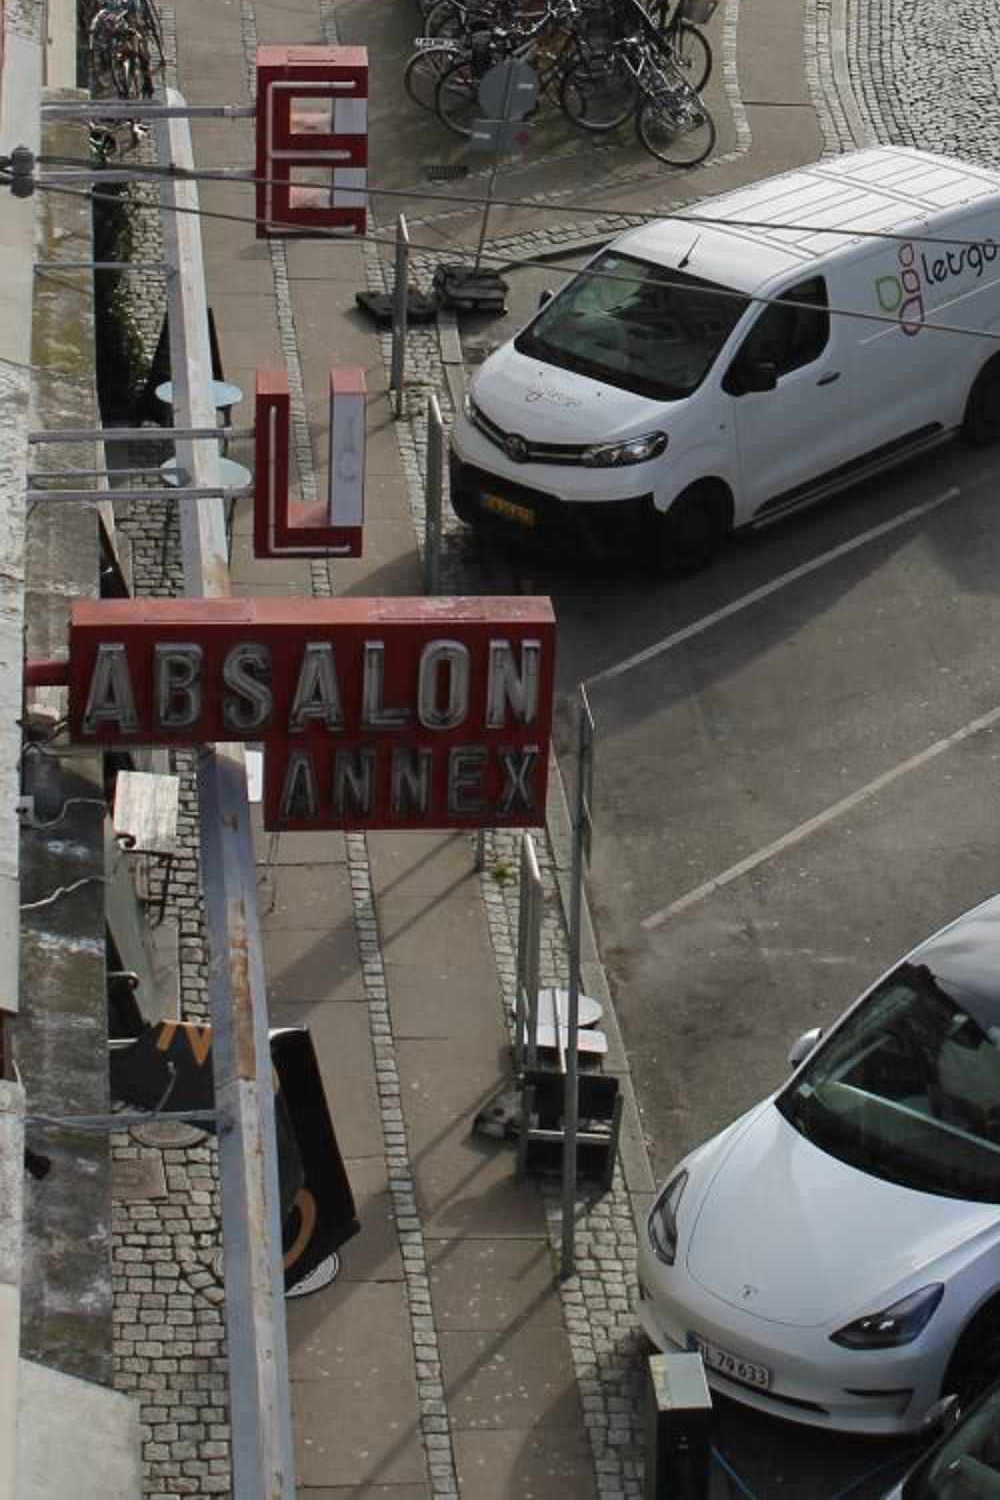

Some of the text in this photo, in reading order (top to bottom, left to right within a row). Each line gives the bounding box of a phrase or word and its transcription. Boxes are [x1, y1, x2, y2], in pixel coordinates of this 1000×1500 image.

[81, 639, 542, 734] ABSALON
[280, 745, 540, 819] ANNEX
[737, 1363, 769, 1386] 633
